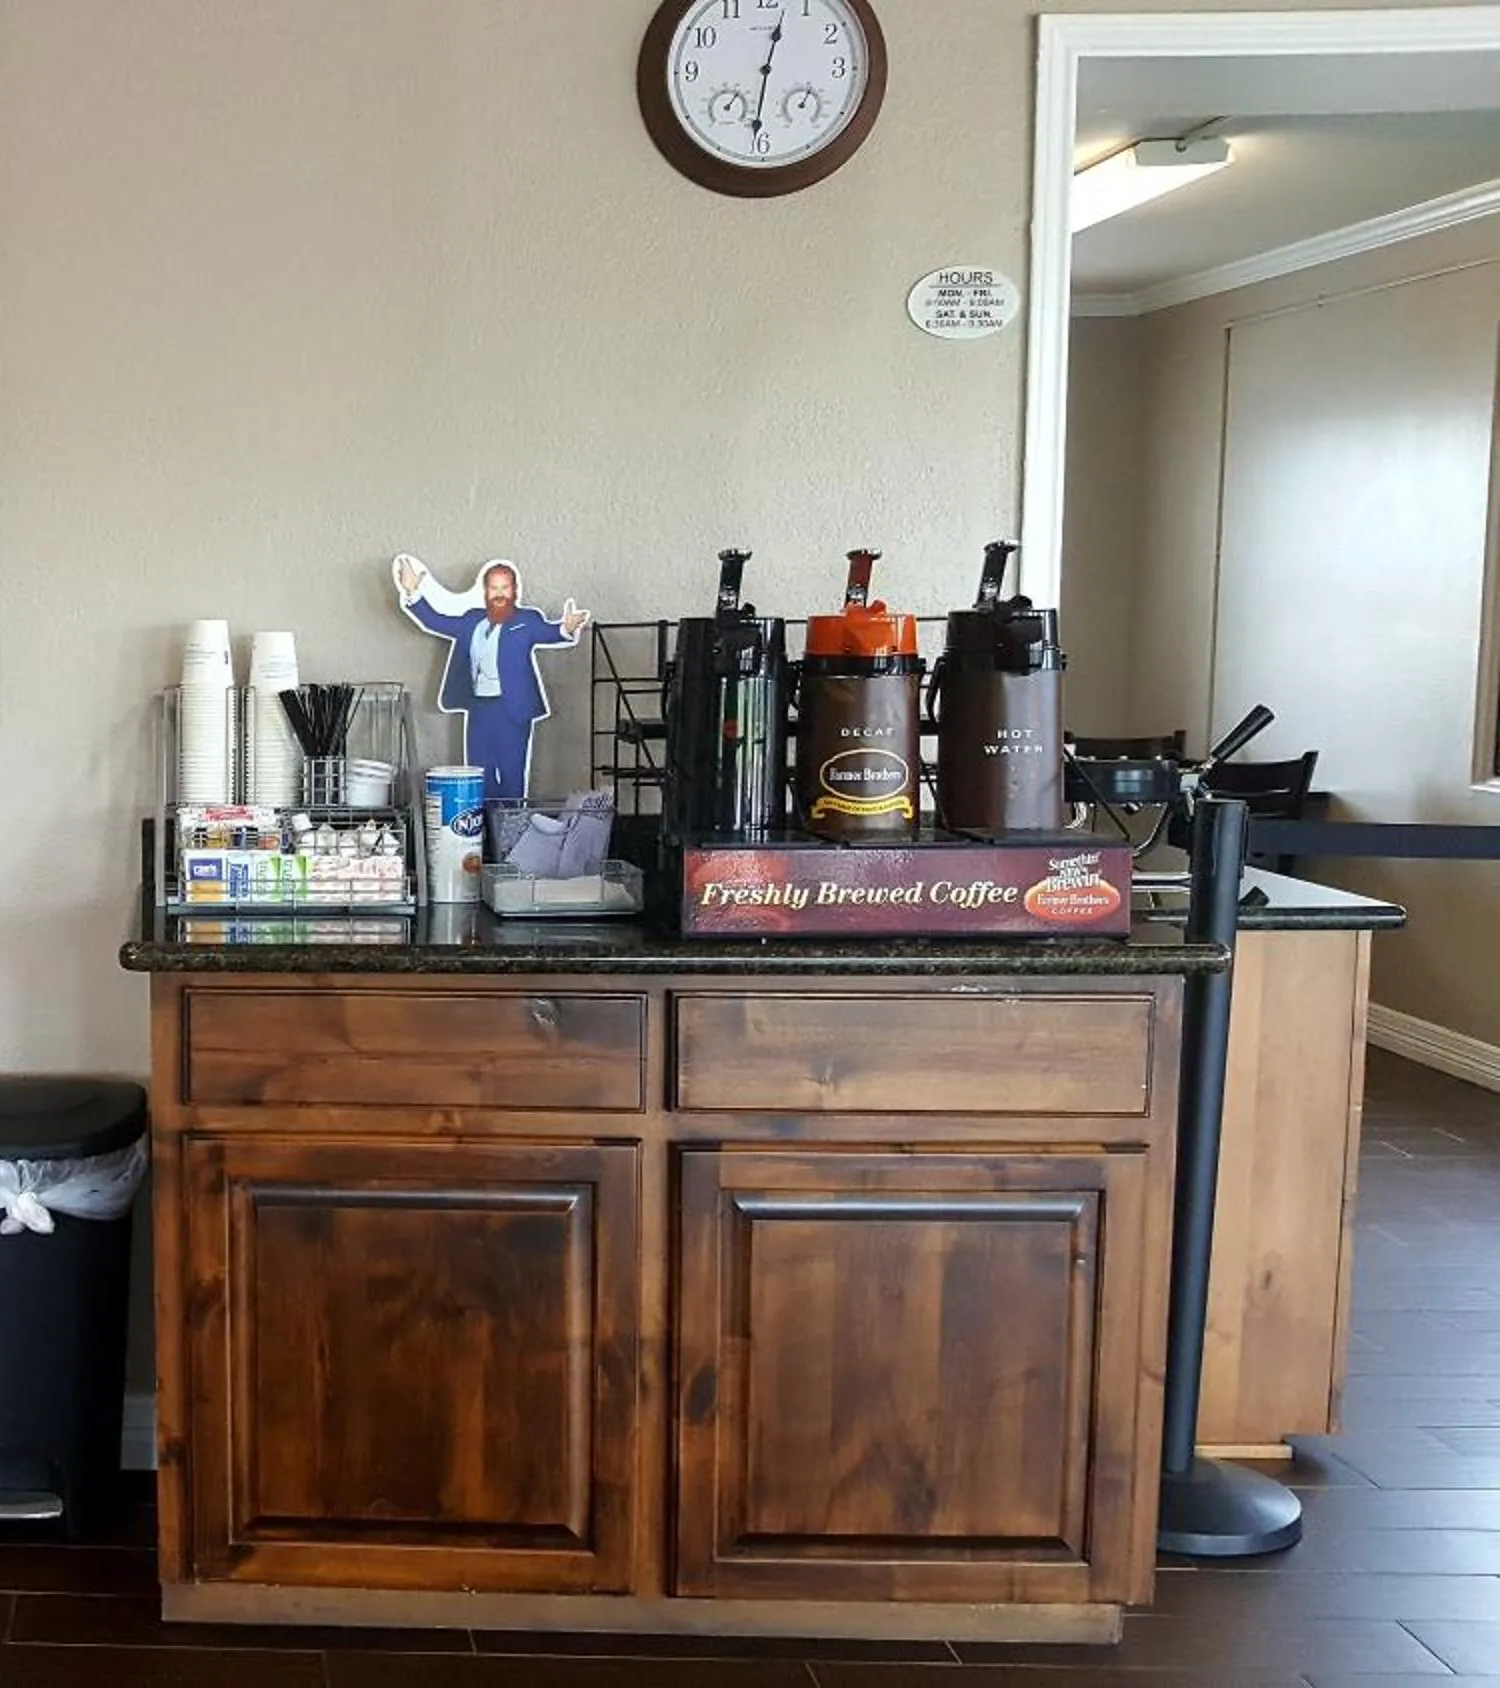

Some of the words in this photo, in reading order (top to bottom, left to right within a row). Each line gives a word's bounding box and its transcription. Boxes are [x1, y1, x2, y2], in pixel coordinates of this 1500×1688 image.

[694, 25, 717, 49] 10
[822, 23, 838, 45] 2
[684, 60, 700, 83] 9
[831, 56, 846, 79] 3
[755, 131, 771, 155] 6
[939, 271, 994, 285] HOURS
[841, 727, 893, 737] DECAF
[997, 729, 1034, 740] HOT
[984, 744, 1044, 755] WATER
[701, 882, 810, 909] Freshly
[817, 882, 923, 906] Brewed
[929, 880, 1019, 910] Coffee
